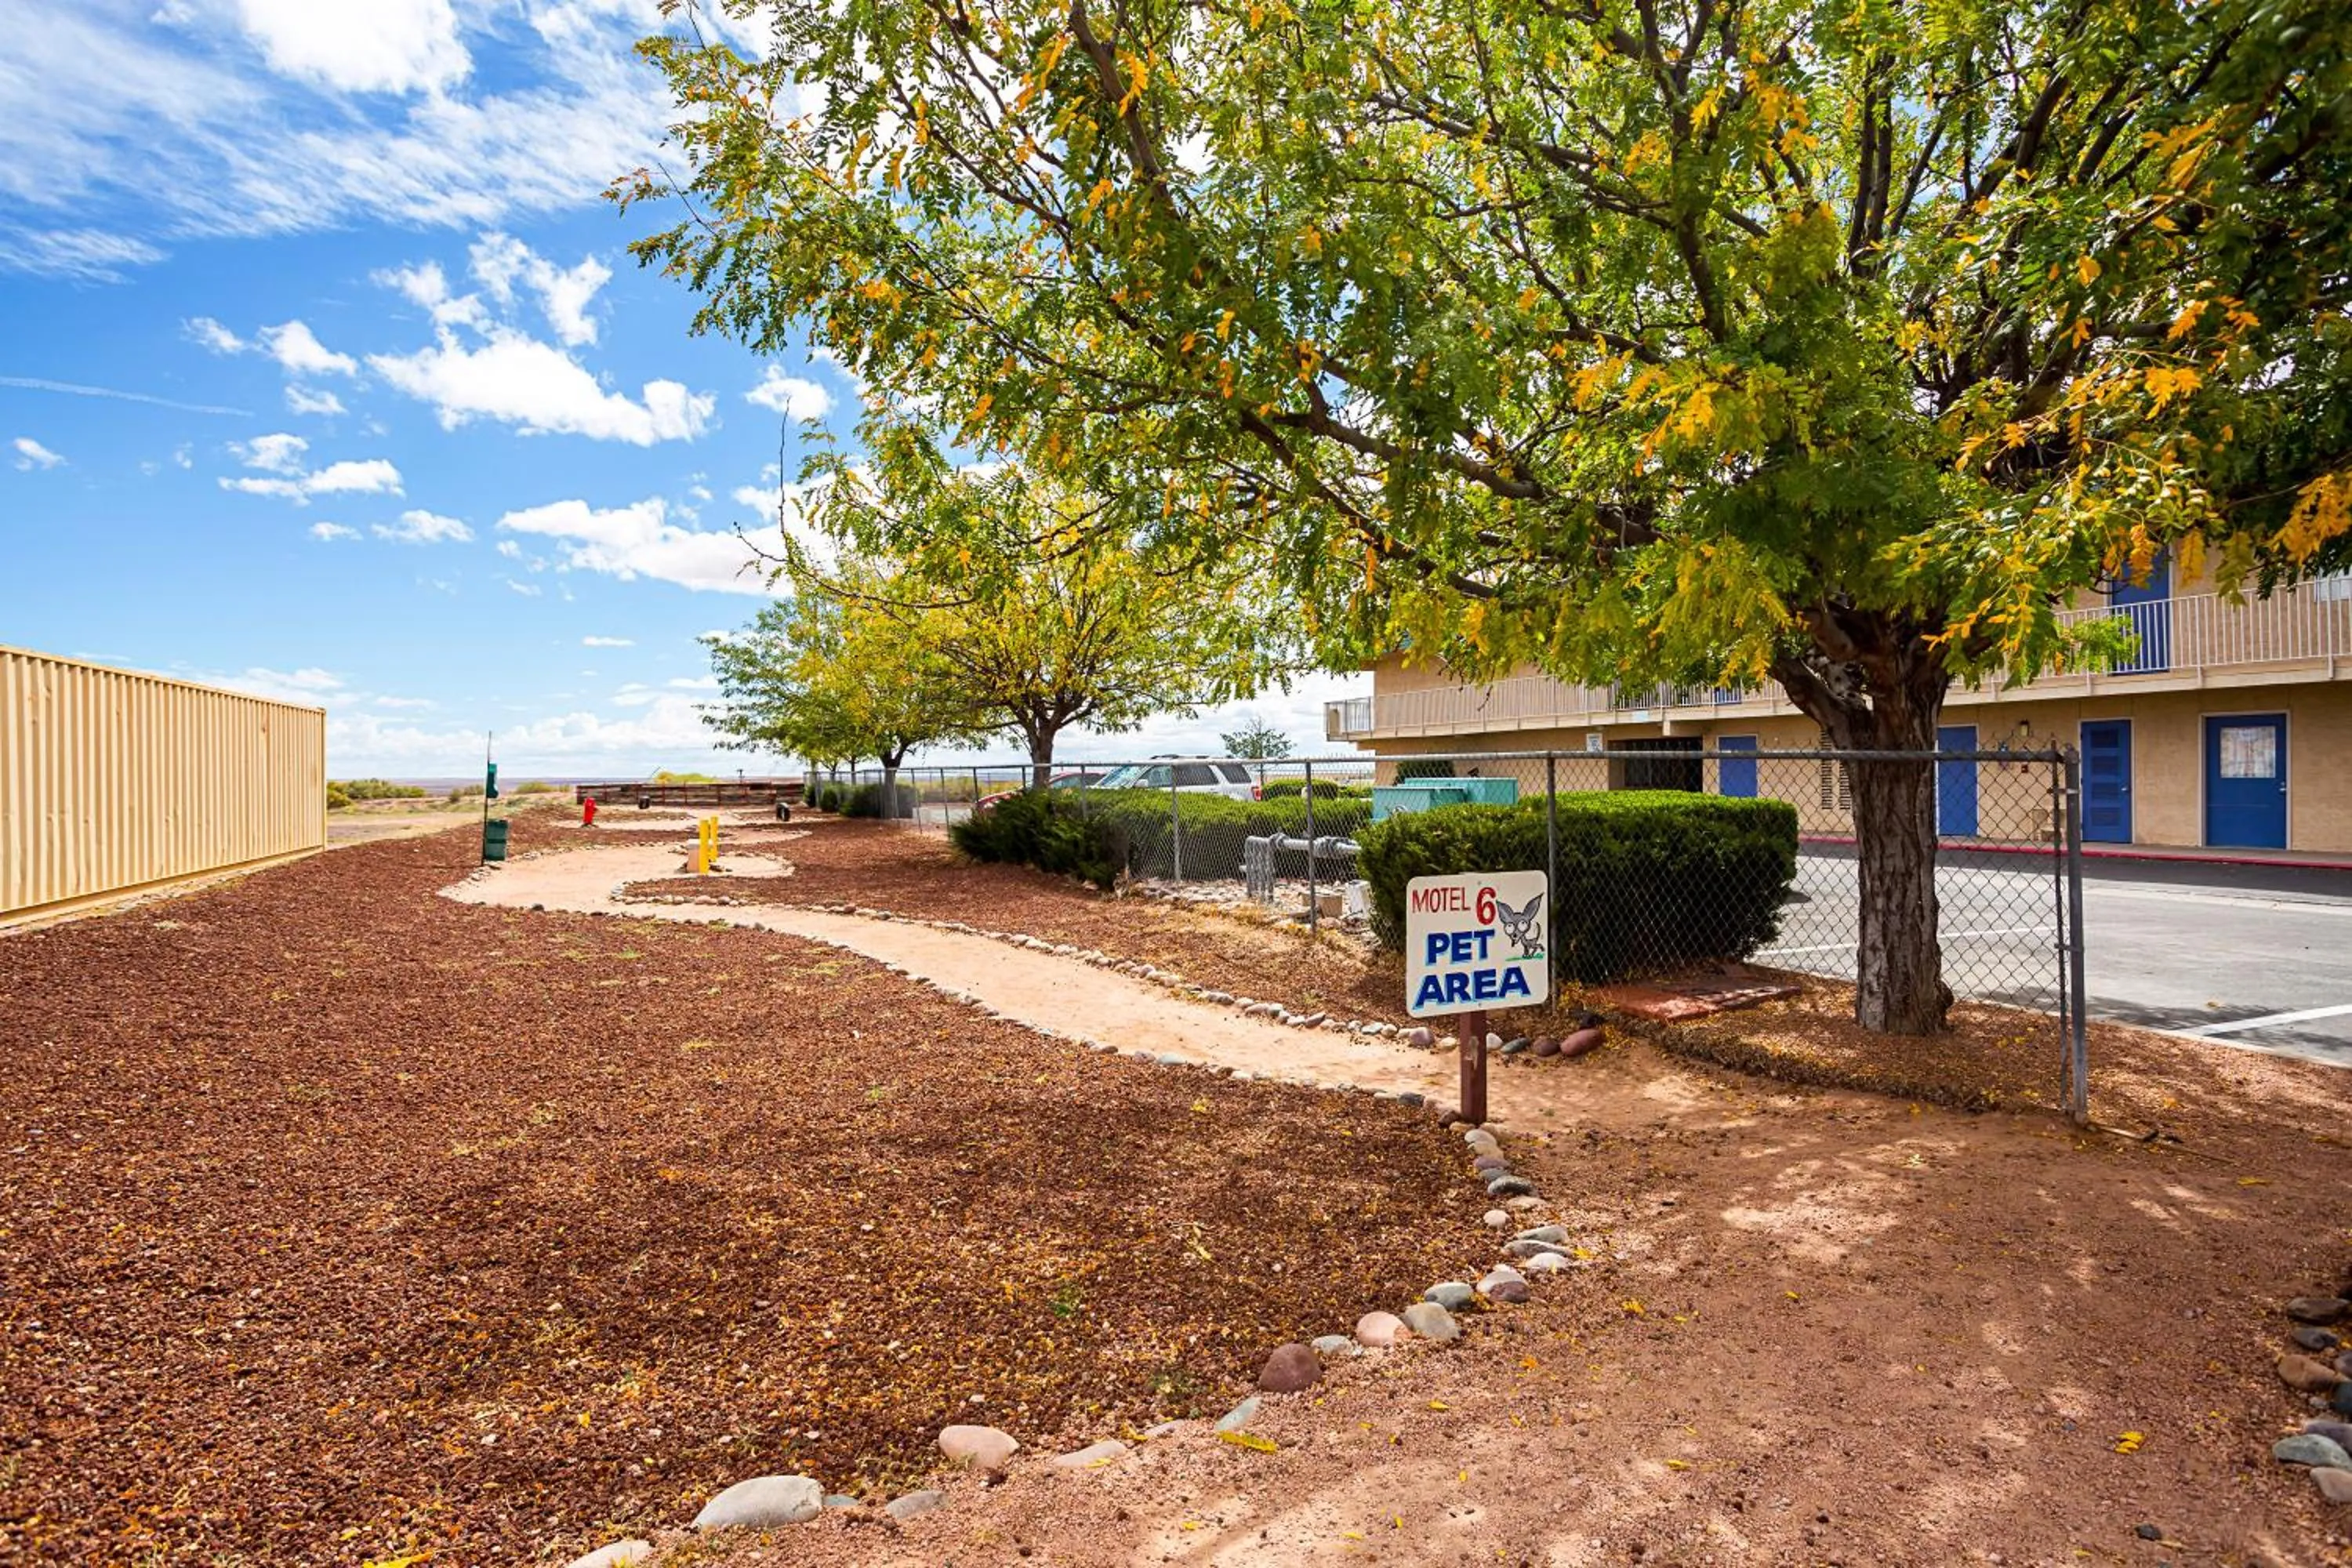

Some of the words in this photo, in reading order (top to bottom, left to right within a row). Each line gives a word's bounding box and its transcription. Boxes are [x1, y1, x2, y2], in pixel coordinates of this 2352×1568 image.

[1412, 887, 1471, 913] MOTEL
[1475, 887, 1497, 926] 6
[1426, 929, 1495, 966] PET
[1412, 966, 1531, 1010] AREA
